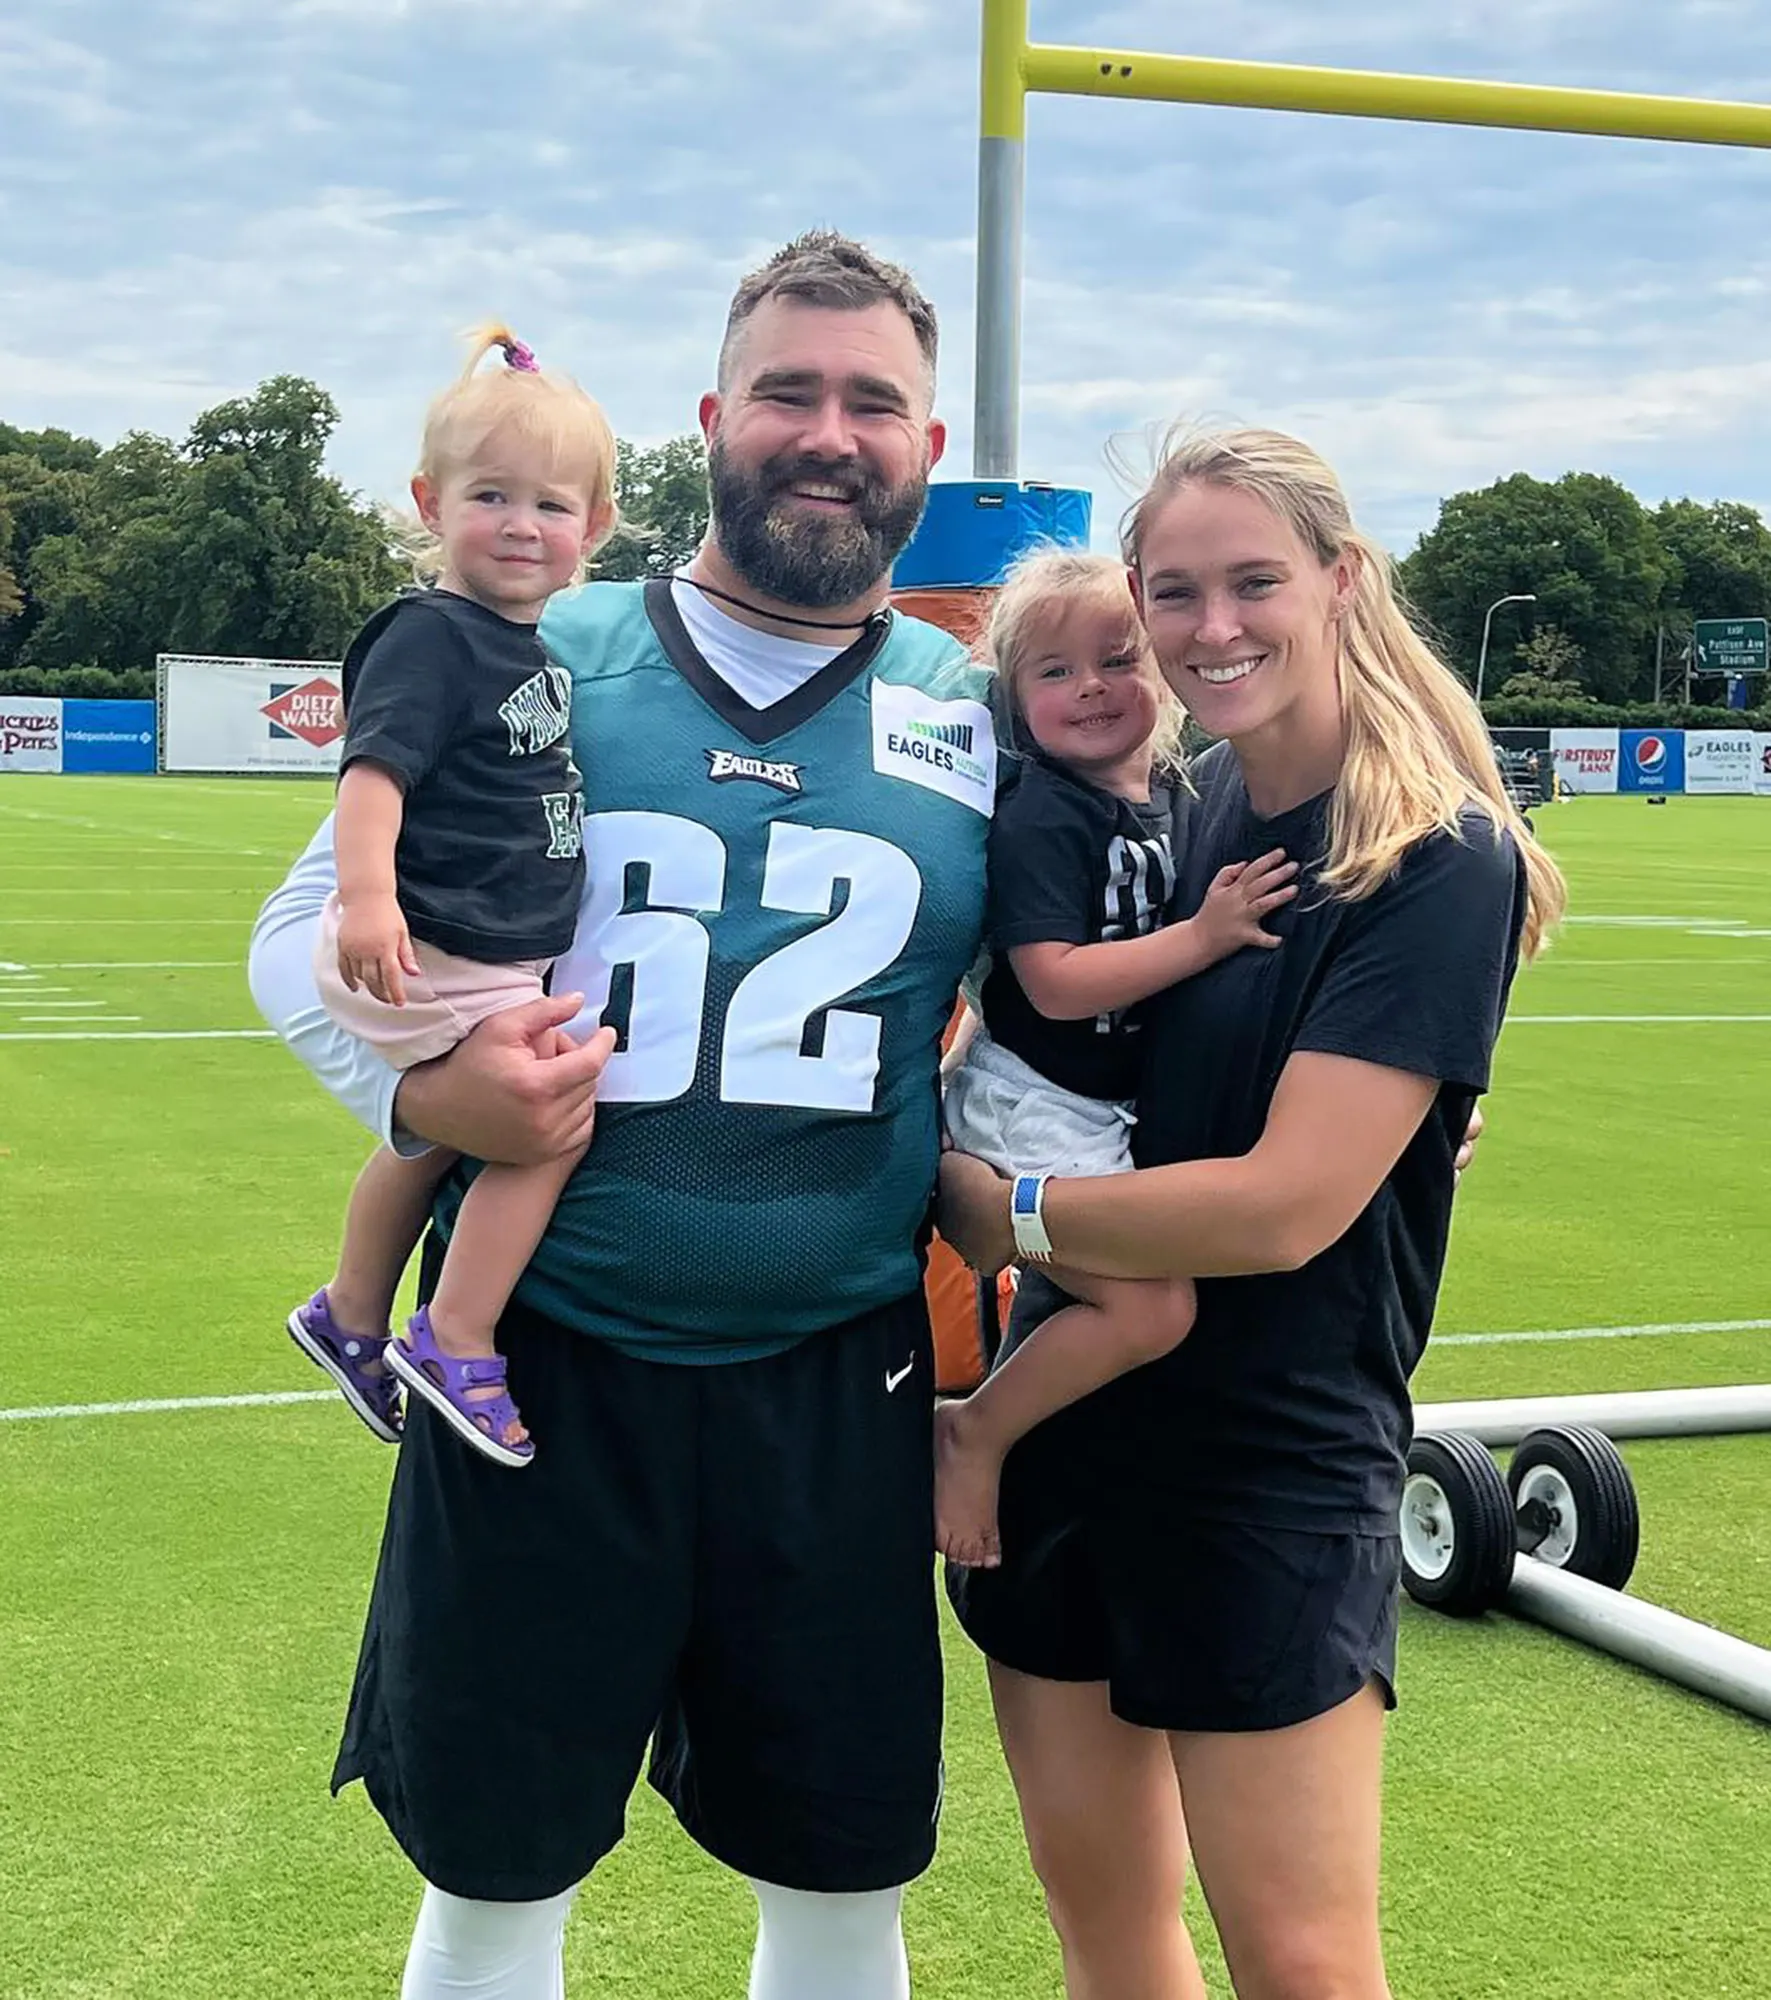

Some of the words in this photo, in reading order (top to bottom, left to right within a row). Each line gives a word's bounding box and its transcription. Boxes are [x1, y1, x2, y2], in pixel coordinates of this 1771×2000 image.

[1747, 637, 1764, 648] Ave
[1720, 654, 1756, 665] Stadium
[64, 729, 138, 742] Independence
[888, 733, 954, 772] EAGLES
[1706, 741, 1752, 753] EAGLES
[1553, 748, 1616, 763] FRSTRUST
[709, 748, 802, 791] EAGLES
[1578, 762, 1612, 773] BANK
[551, 810, 922, 1112] 62
